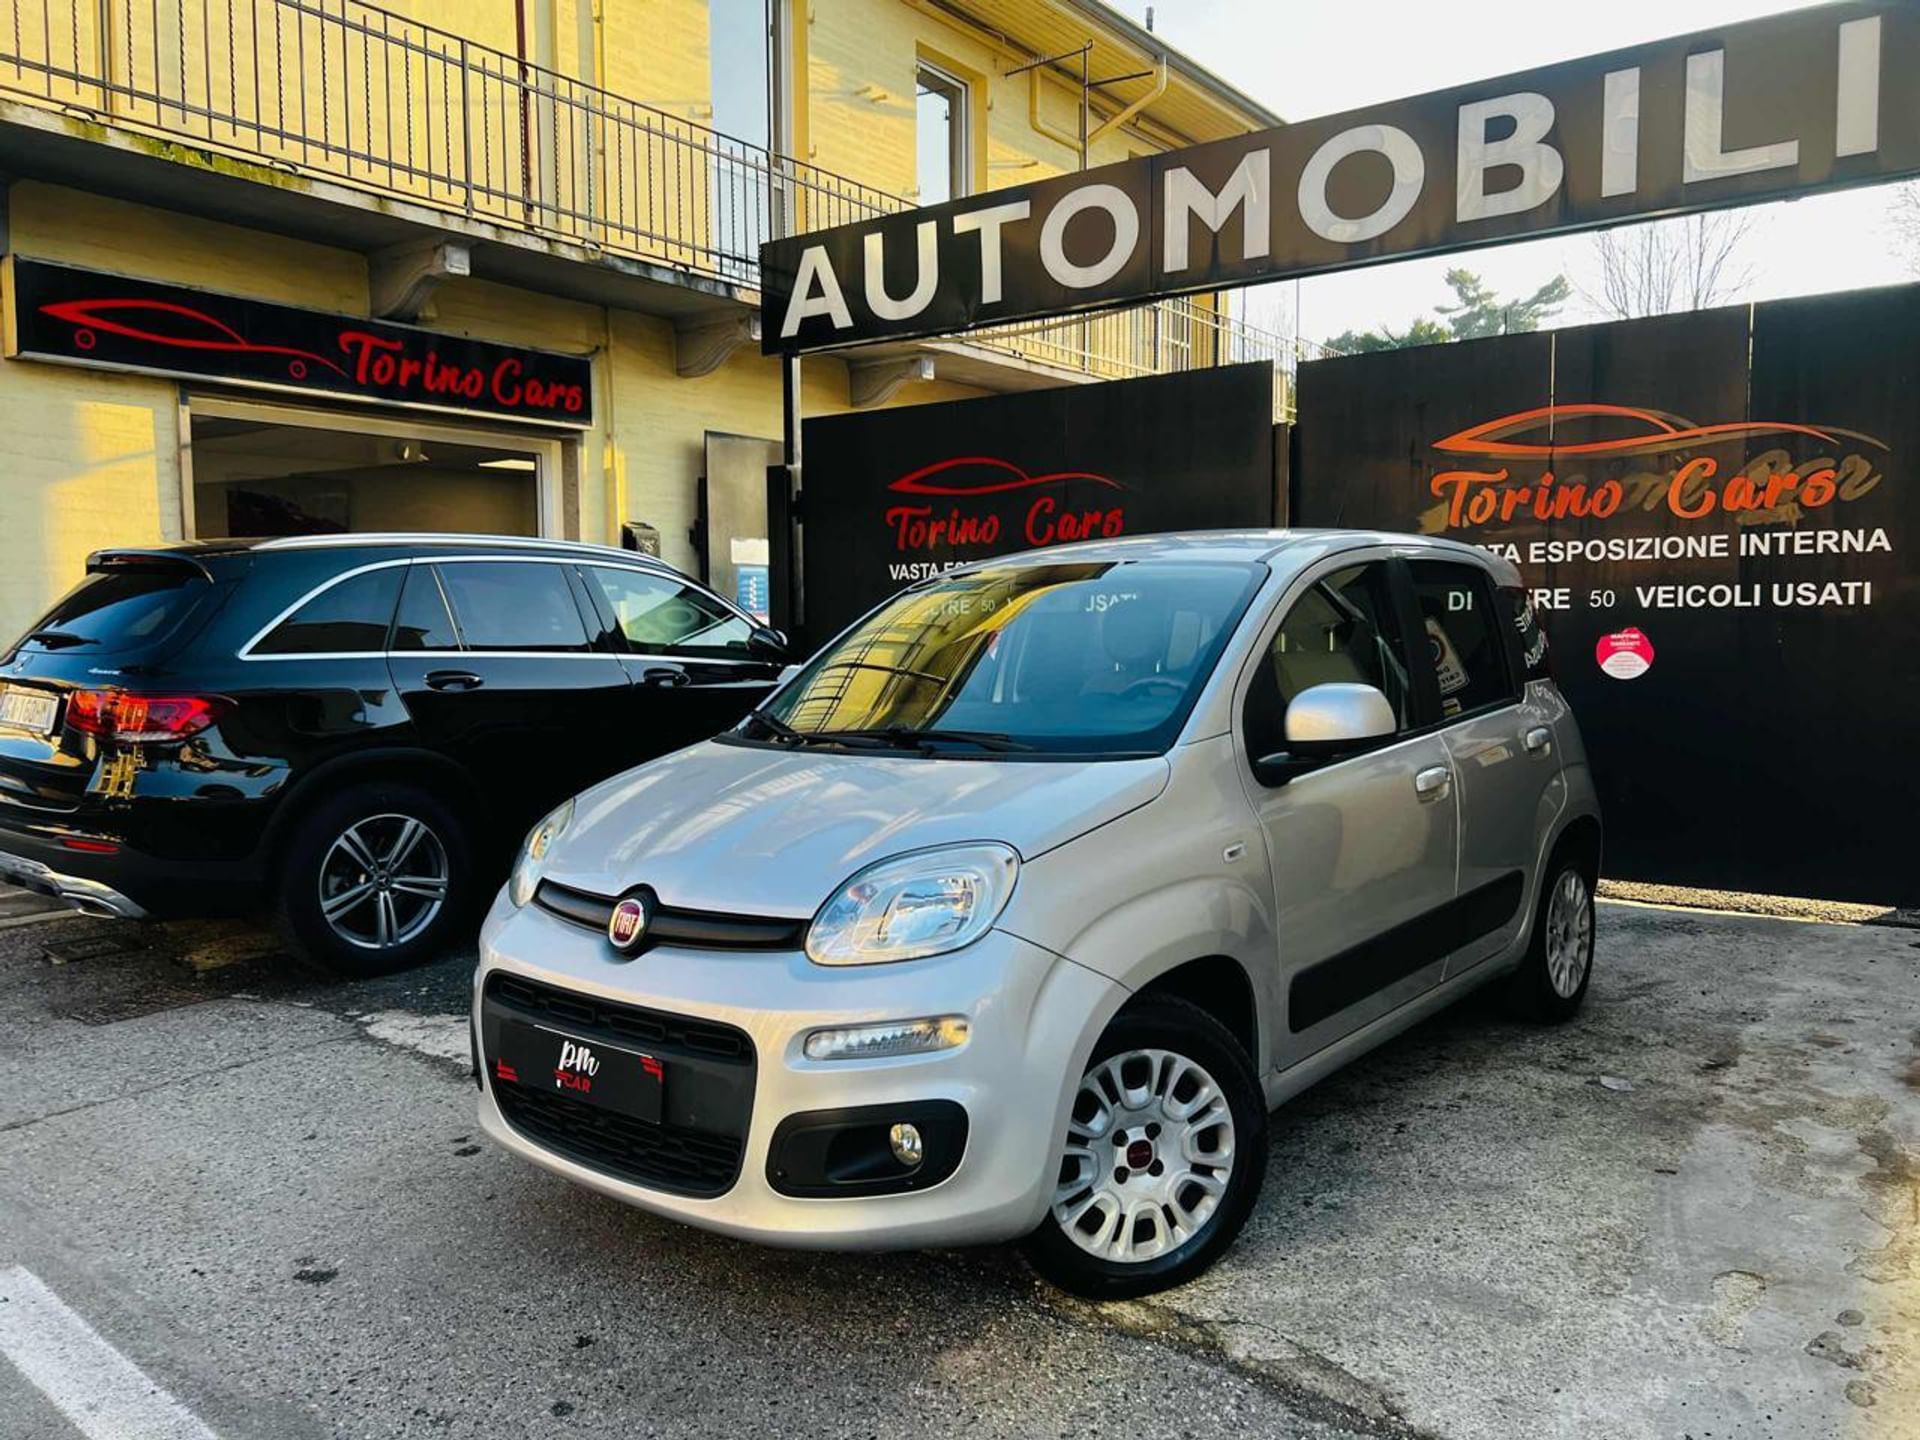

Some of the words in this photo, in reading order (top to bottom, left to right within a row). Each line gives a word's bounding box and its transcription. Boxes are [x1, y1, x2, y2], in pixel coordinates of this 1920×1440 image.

[780, 15, 1881, 339] AUTOMOBILI
[338, 331, 484, 398] Torino
[491, 357, 583, 412] Cars
[1430, 468, 1623, 528] Torino
[1667, 457, 1839, 519] Cars
[885, 505, 999, 549] Torino
[1025, 496, 1124, 545] Cars
[1528, 534, 1729, 564] ESPOSIZIONE
[1739, 528, 1892, 557] INTERNA
[1448, 590, 1473, 611] DI
[1589, 589, 1616, 608] 50
[1635, 583, 1761, 609] VEICOLI
[1772, 581, 1872, 606] USATI
[615, 910, 639, 935] FIAT
